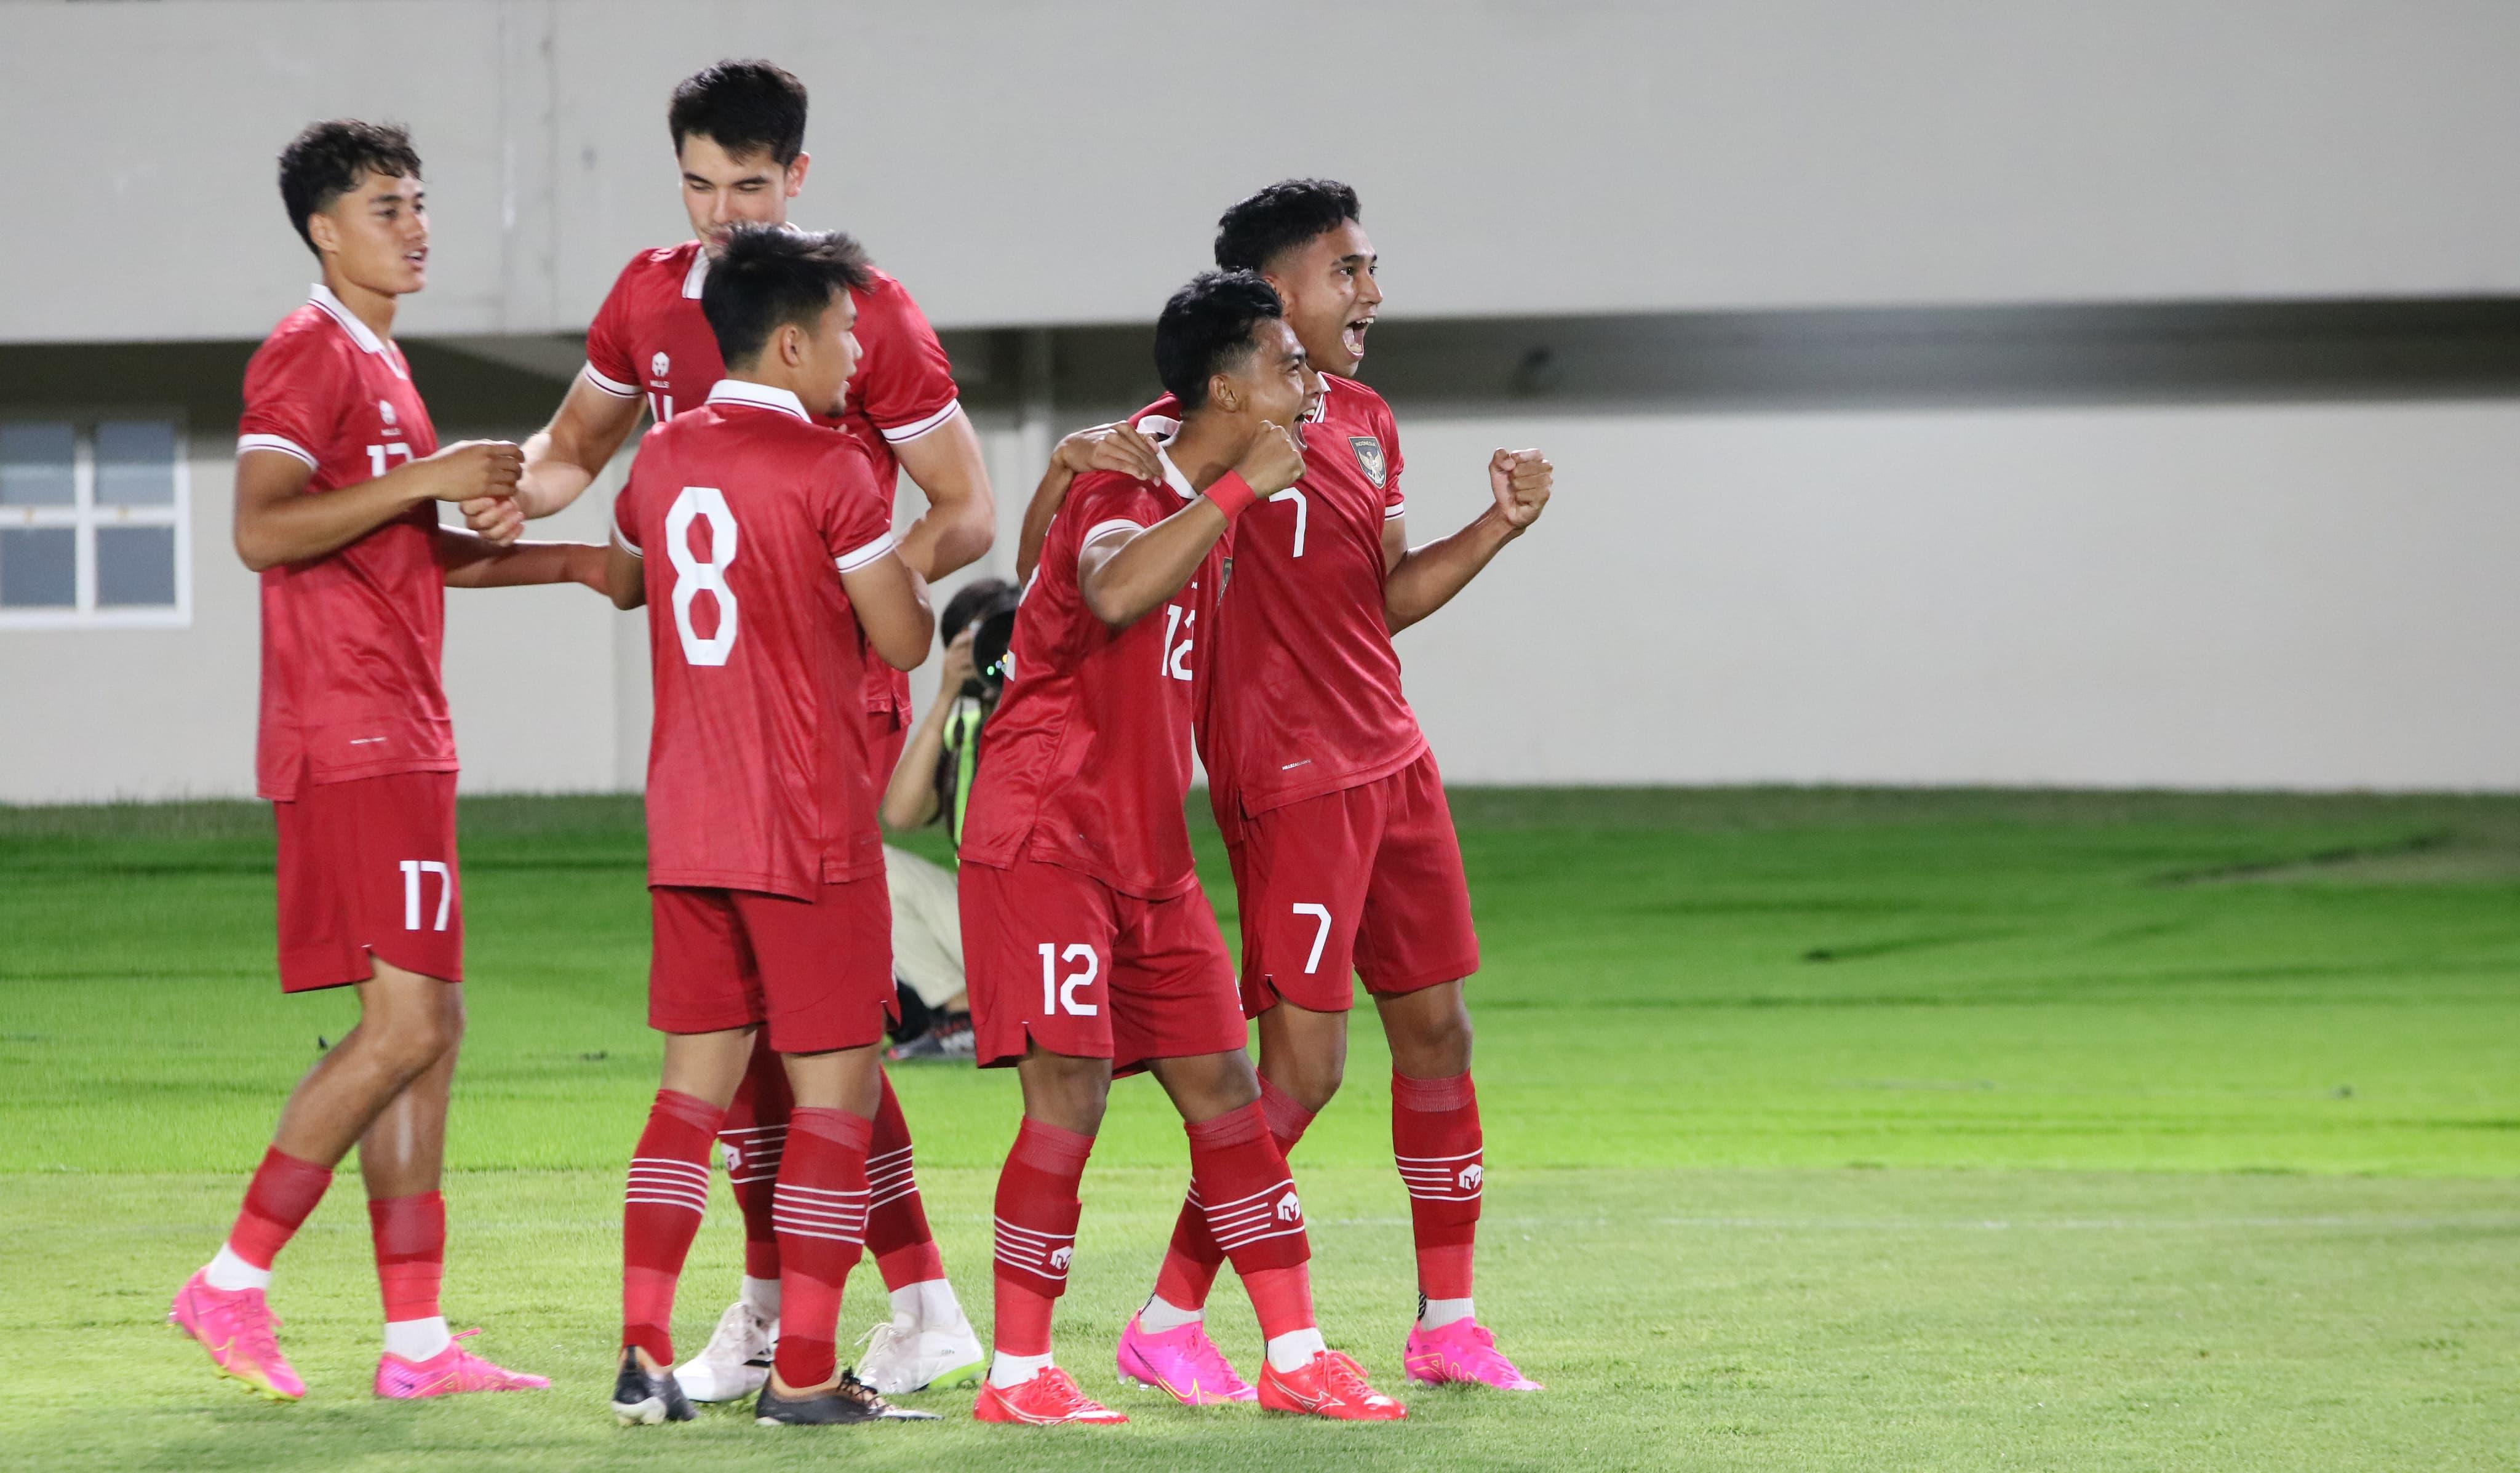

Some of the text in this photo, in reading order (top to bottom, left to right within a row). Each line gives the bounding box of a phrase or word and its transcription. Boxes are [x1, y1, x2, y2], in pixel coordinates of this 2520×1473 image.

[1269, 487, 1307, 558] 7
[664, 485, 738, 667] 8
[1161, 604, 1196, 681] 12
[399, 860, 452, 932] 17
[1293, 902, 1332, 974] 7
[1038, 943, 1098, 1016] 12
